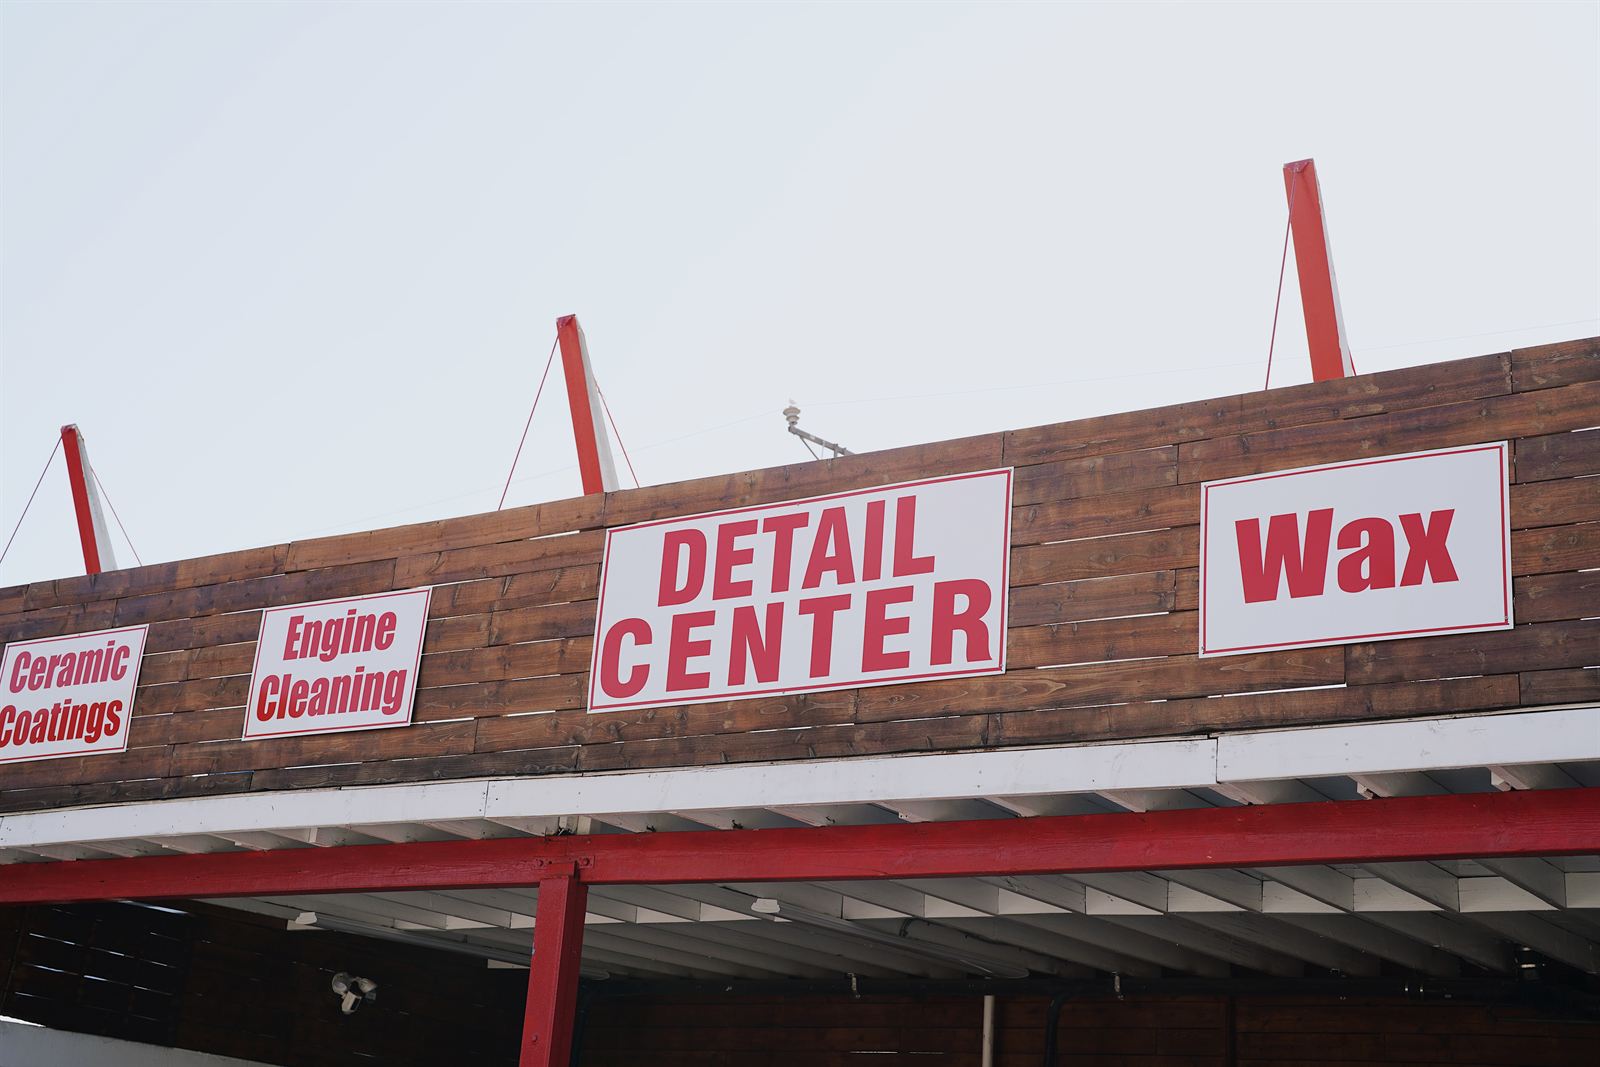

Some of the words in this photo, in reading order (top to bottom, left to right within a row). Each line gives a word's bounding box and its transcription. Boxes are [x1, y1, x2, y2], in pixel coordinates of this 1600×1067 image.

[657, 495, 936, 607] DETAIL
[1235, 507, 1460, 604] Wax
[283, 608, 397, 662] Engine
[600, 578, 993, 699] CENTER
[9, 640, 130, 694] Ceramic
[256, 666, 408, 722] Cleaning
[0, 698, 123, 748] Coatings
